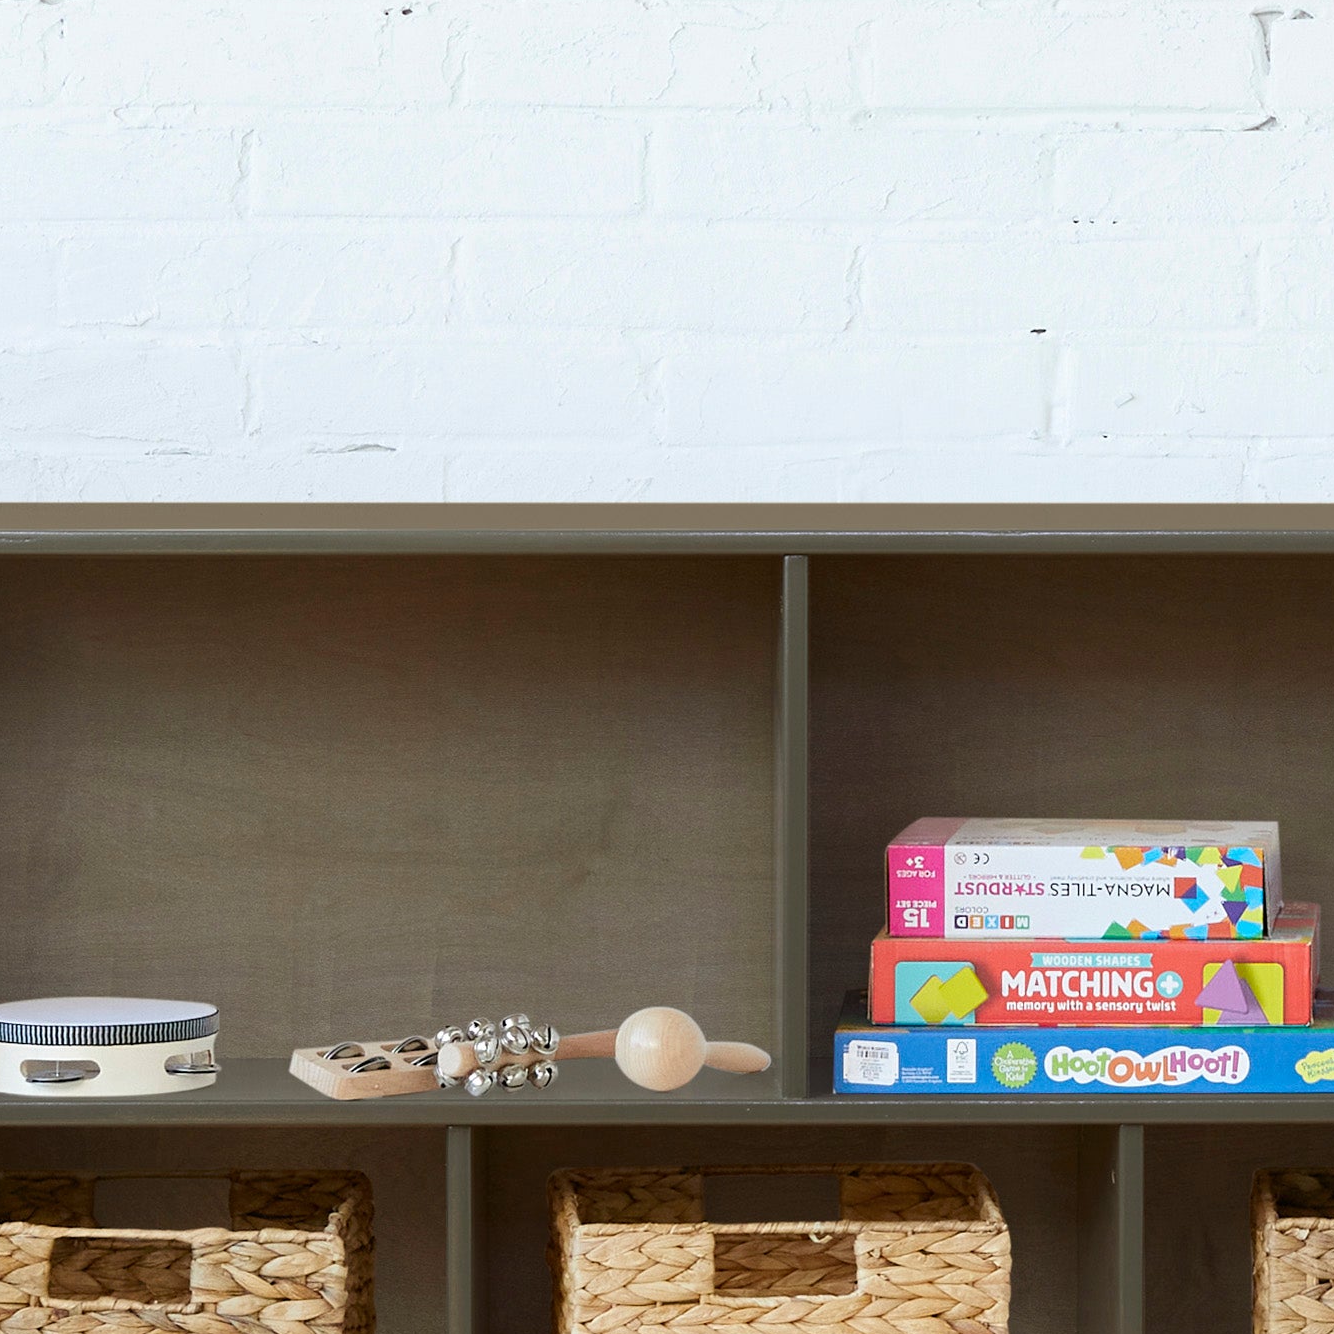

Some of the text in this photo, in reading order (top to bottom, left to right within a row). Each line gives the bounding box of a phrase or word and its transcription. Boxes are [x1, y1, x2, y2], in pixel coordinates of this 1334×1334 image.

[905, 855, 925, 869] 3+
[896, 870, 936, 878] FOR AGES
[1050, 882, 1171, 897] MAGNA-TILES
[896, 900, 937, 908] PIECE SET
[955, 906, 989, 914] COLORS
[902, 908, 930, 928] 15
[1042, 955, 1141, 966] WOODEN SHAPES
[1006, 1000, 1177, 1013] memory with a sensory twist
